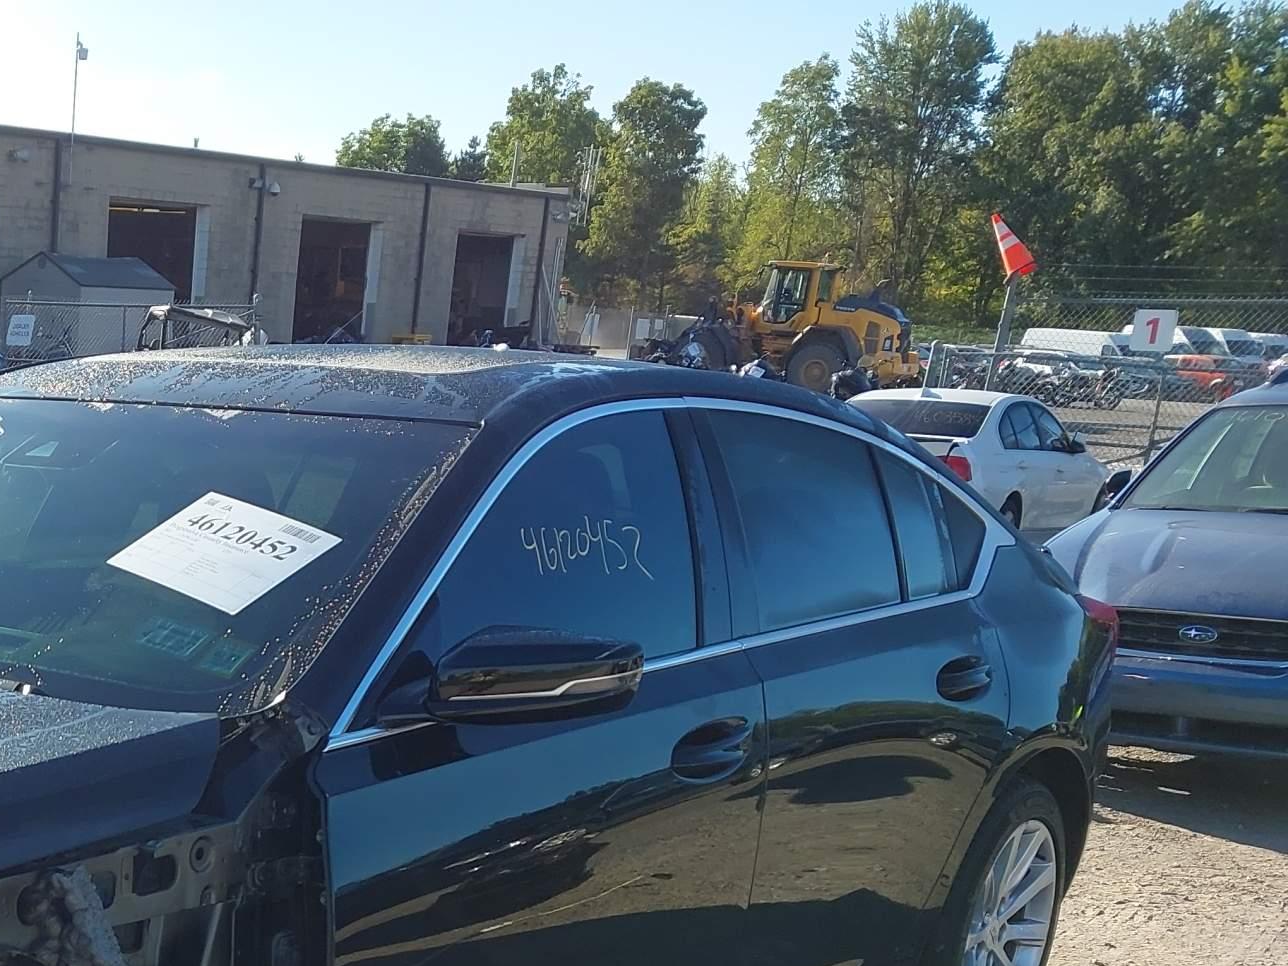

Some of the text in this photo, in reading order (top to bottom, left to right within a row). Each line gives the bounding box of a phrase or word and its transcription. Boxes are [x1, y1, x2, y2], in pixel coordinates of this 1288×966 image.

[1146, 317, 1161, 345] 1
[187, 513, 298, 561] 46120452
[520, 515, 655, 580] 46120452
